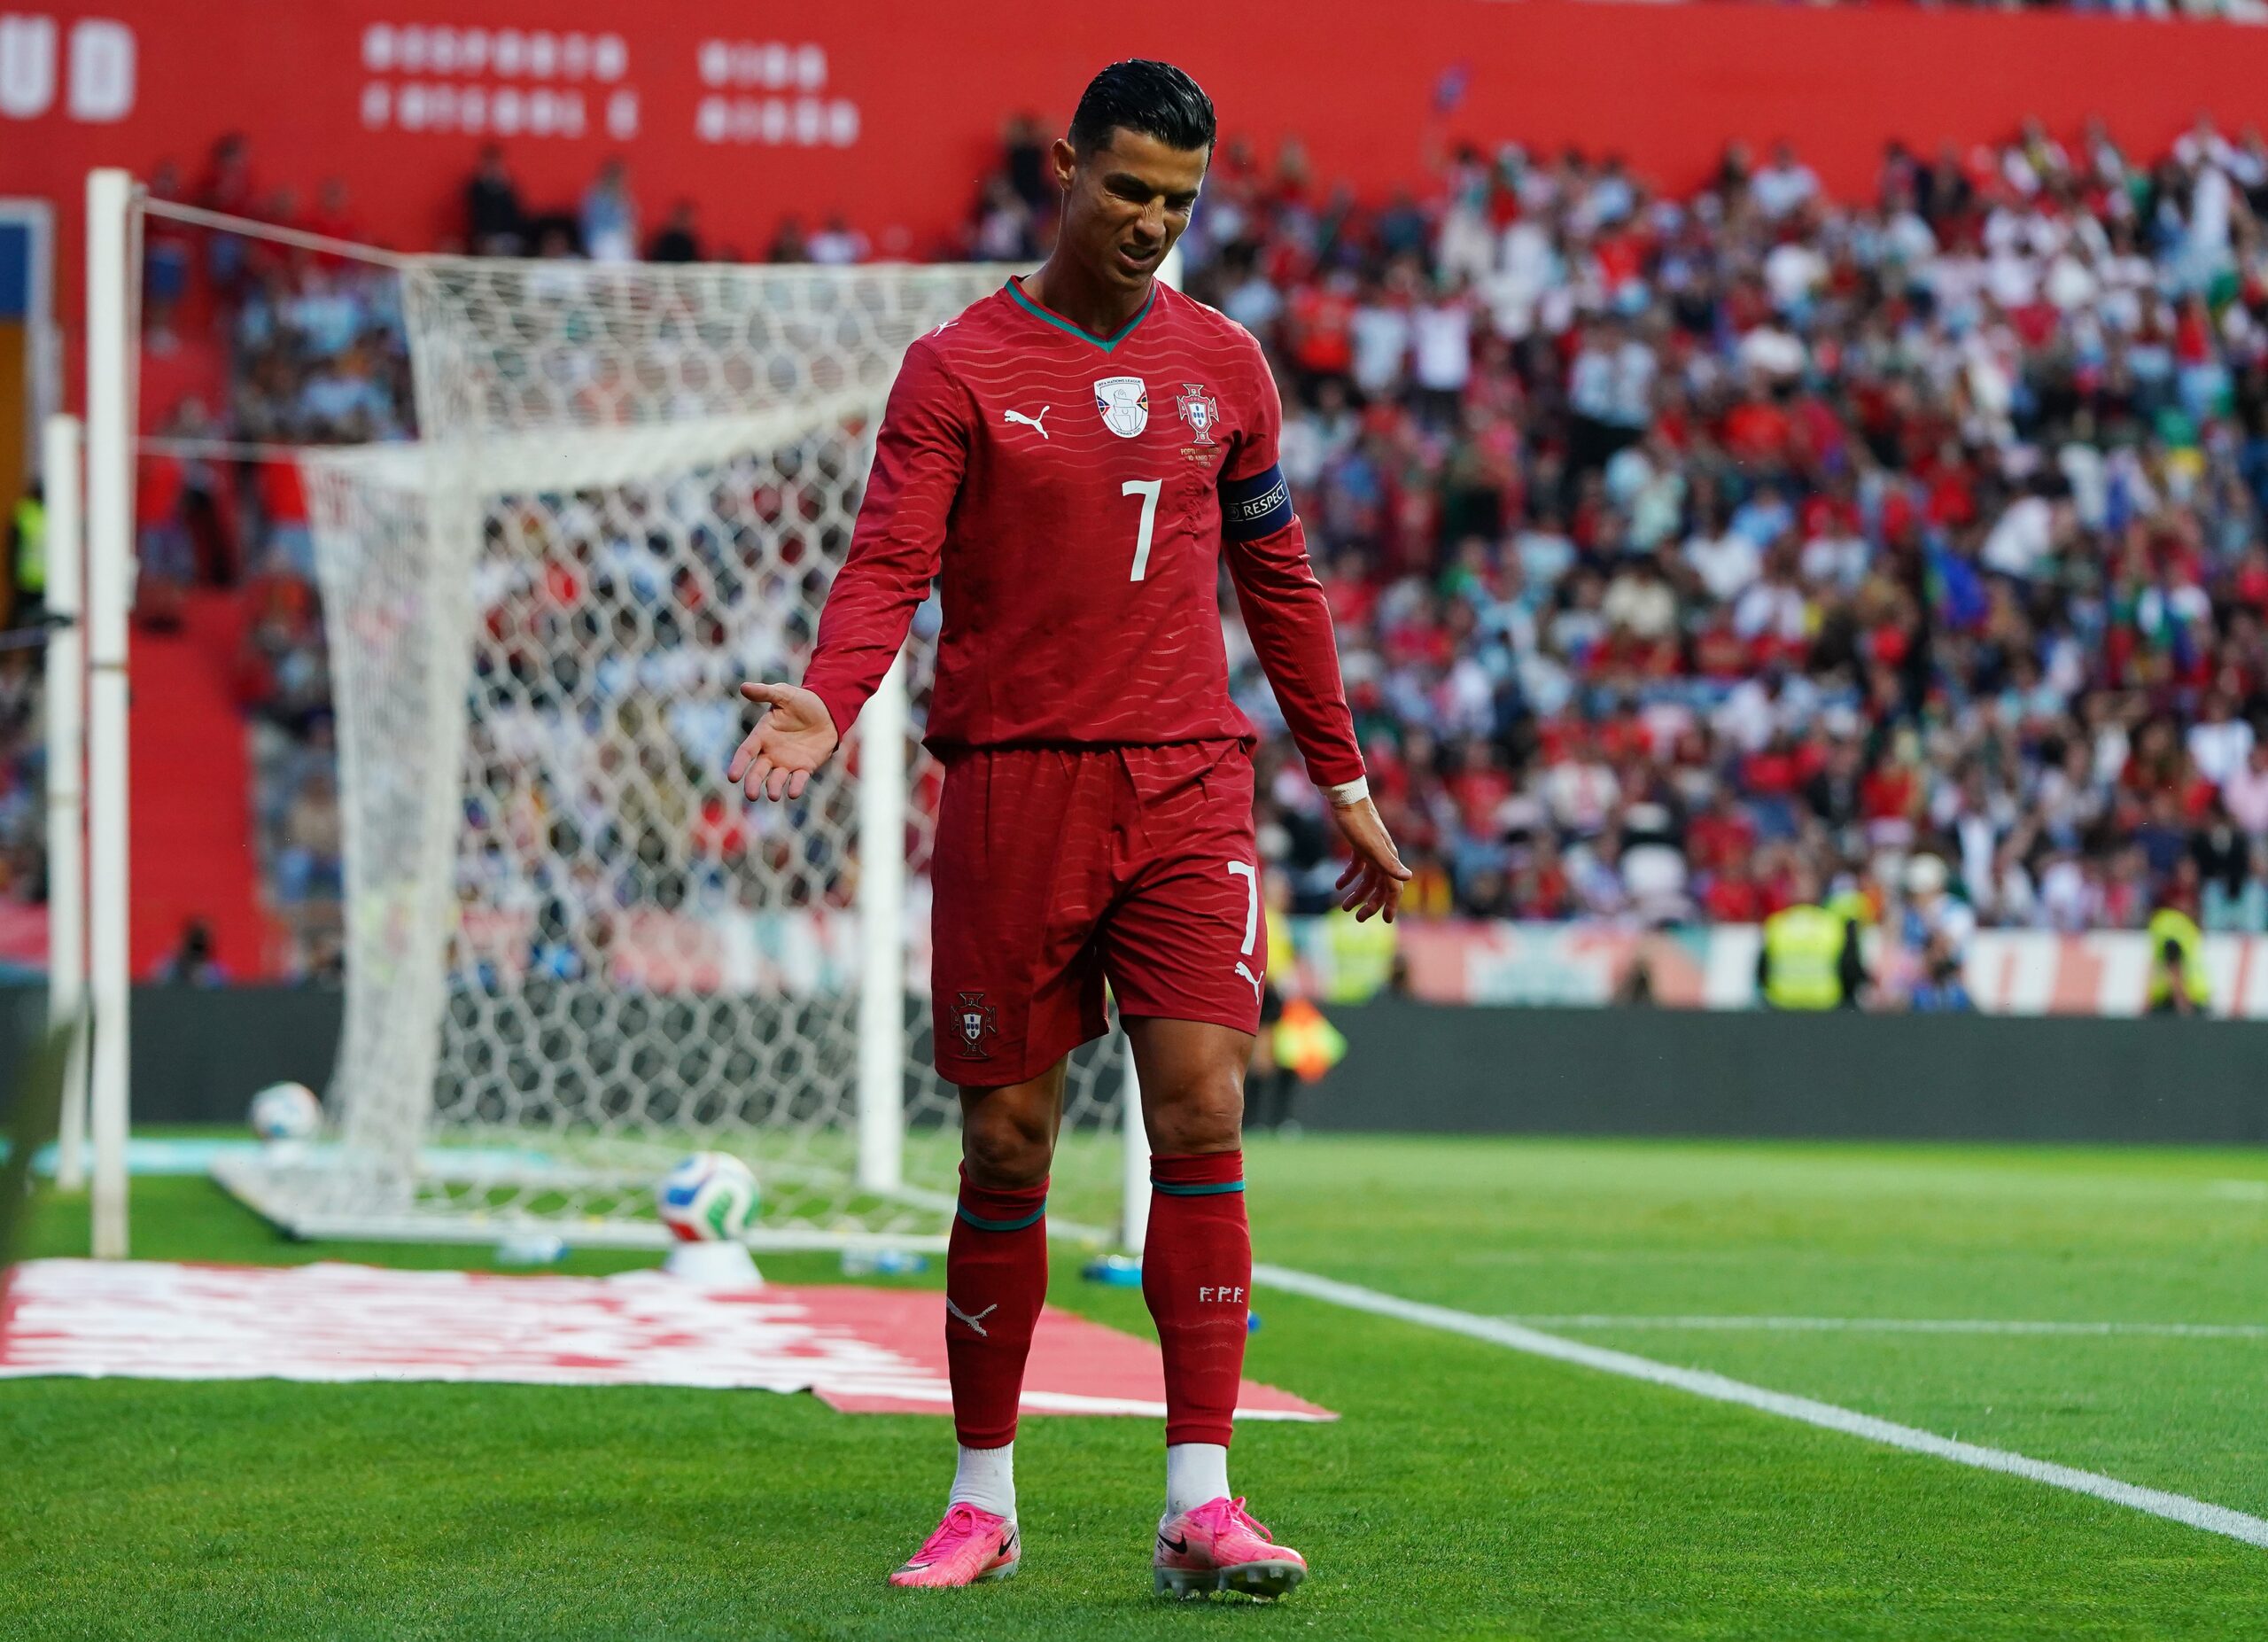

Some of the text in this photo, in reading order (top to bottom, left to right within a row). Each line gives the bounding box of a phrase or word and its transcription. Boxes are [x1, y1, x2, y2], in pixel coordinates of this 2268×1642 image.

[1122, 479, 1162, 582] 7
[1243, 484, 1285, 517] RESPECT
[1227, 860, 1258, 956] 7
